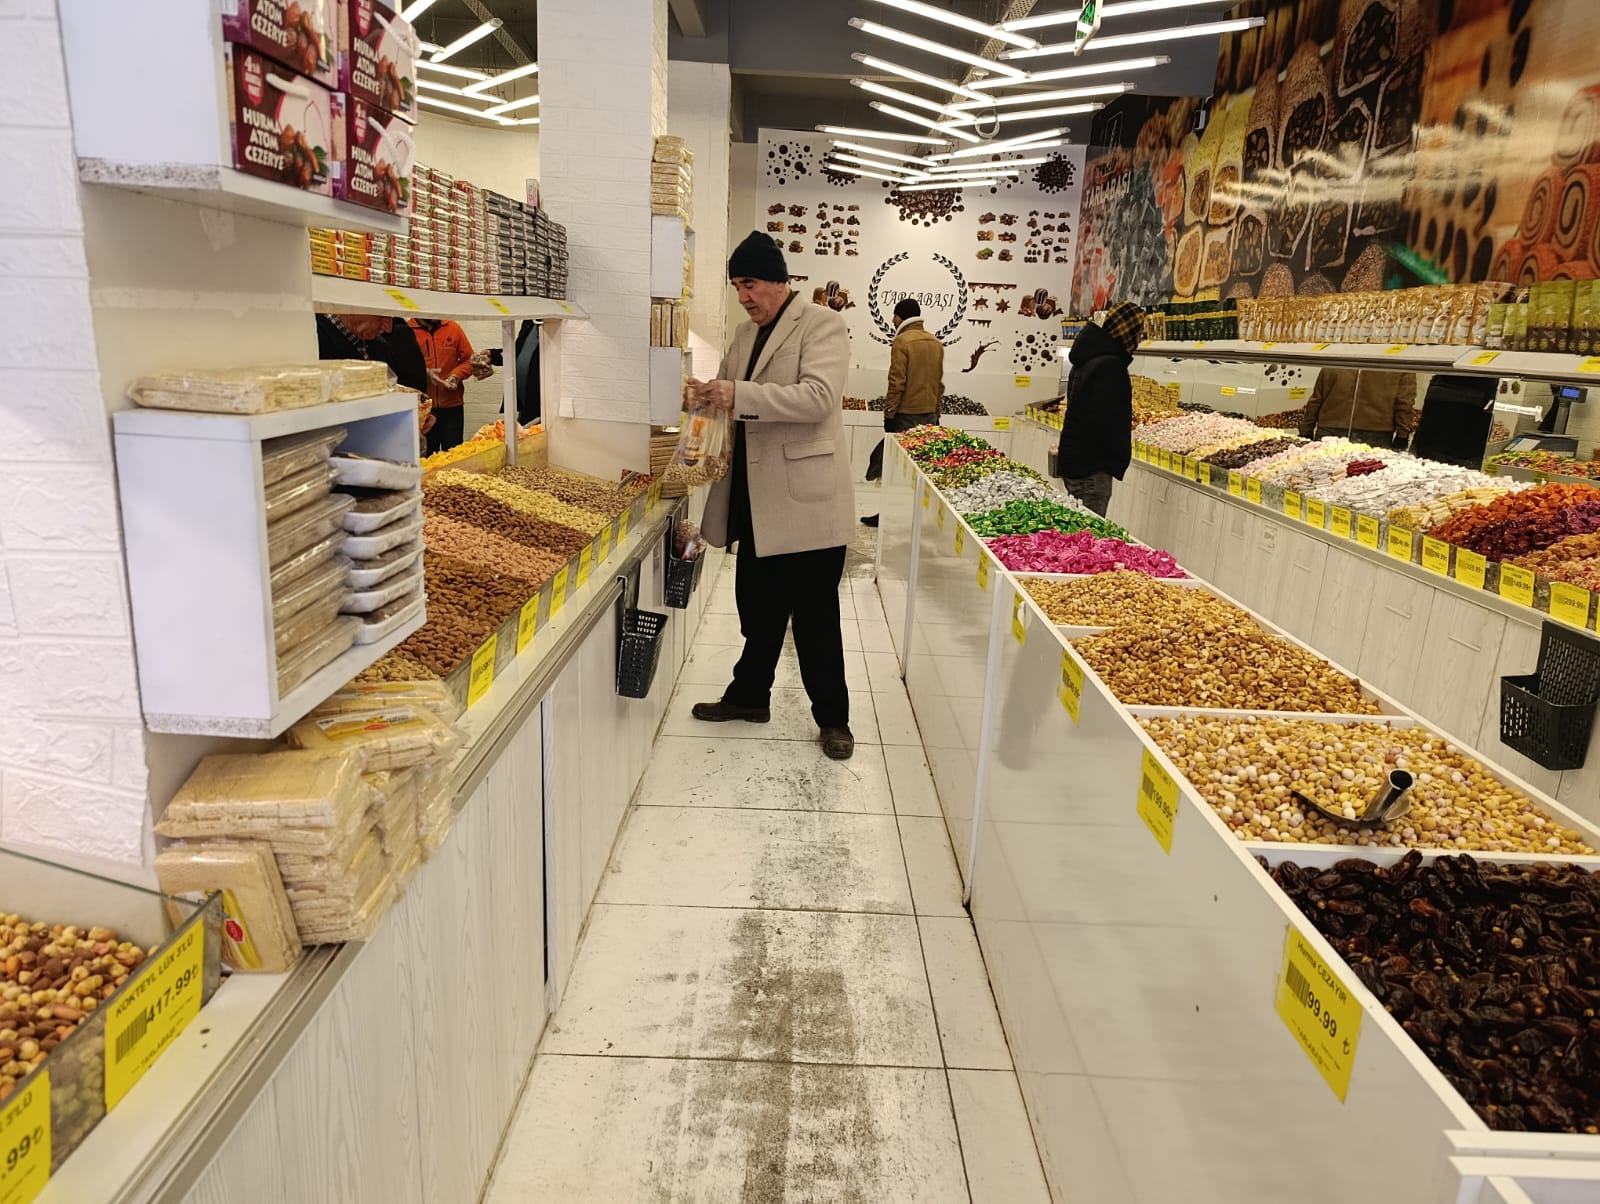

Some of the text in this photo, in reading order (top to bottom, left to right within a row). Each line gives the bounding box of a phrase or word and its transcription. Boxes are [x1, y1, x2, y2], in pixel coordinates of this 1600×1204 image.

[256, 0, 283, 26] ATOM
[251, 13, 288, 48] CEZERYE
[353, 36, 379, 64] HURMA
[356, 56, 376, 78] ATOM
[352, 69, 380, 96] CEZERYE
[242, 106, 281, 135] HURMA
[249, 127, 279, 151] ATOM
[244, 144, 285, 171] CEZERYE
[351, 145, 376, 167] HURMA
[355, 162, 374, 181] ATOM
[350, 176, 378, 198] CEZERYE
[1297, 942, 1317, 969] Hurma
[115, 972, 157, 1019] KOKTEYL
[1307, 990, 1338, 1038] 99.99
